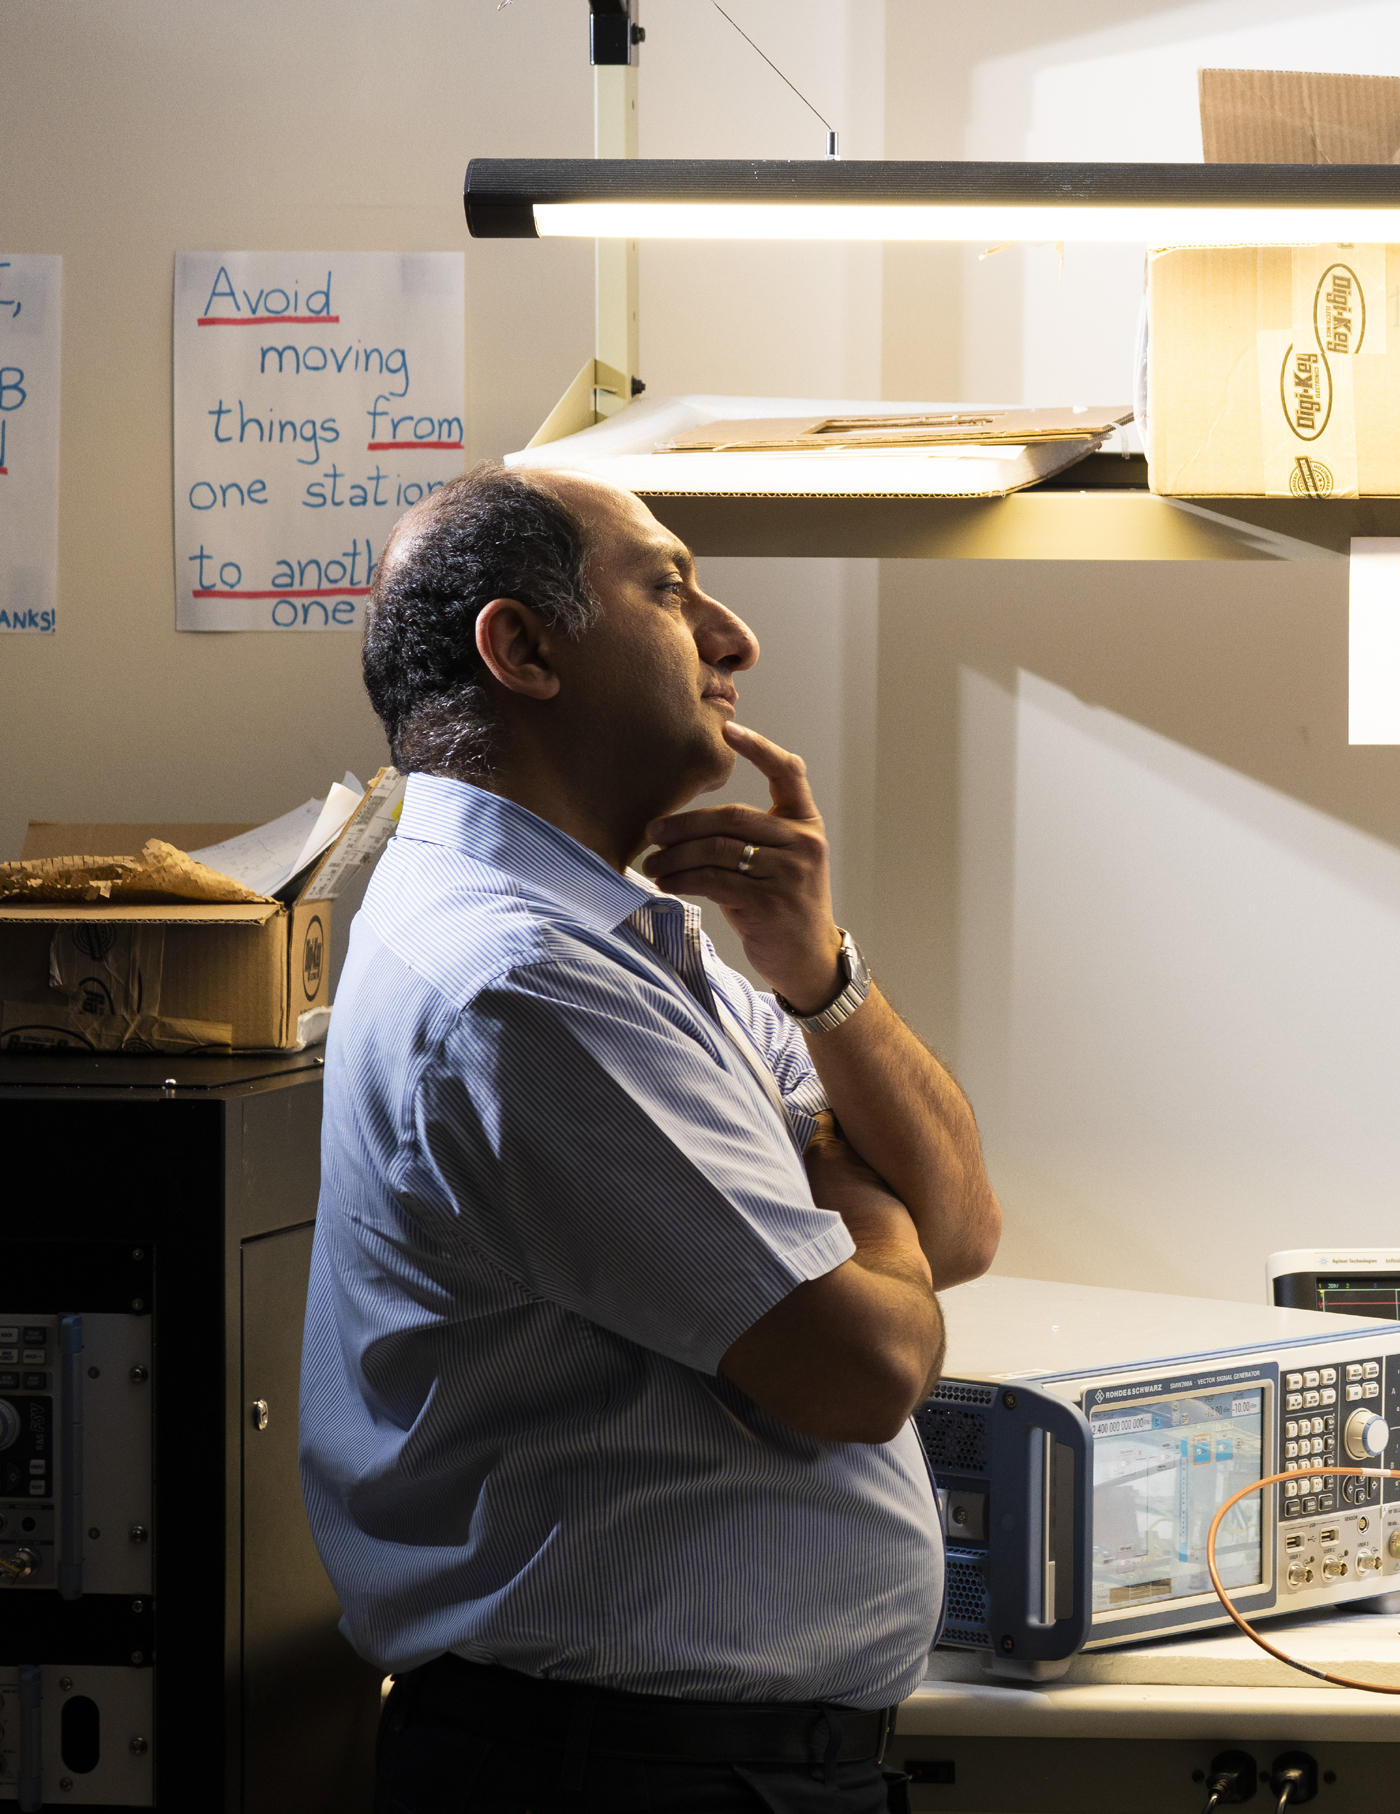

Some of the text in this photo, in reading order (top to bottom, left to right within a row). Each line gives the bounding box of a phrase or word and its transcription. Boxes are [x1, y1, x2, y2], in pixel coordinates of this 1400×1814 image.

[204, 265, 332, 317] Avoid
[260, 338, 410, 398] moving
[208, 394, 464, 466] things from
[189, 479, 268, 511] one
[188, 538, 377, 590] to anoth
[271, 599, 356, 627] one
[1105, 1384, 1162, 1399] ROHDE&SCHWARZ
[1170, 1369, 1261, 1390] SMW200A VECTOR SIGNAL GENERATOR
[1232, 1401, 1250, 1413] -10.00
[36, 1433, 44, 1451] R&S
